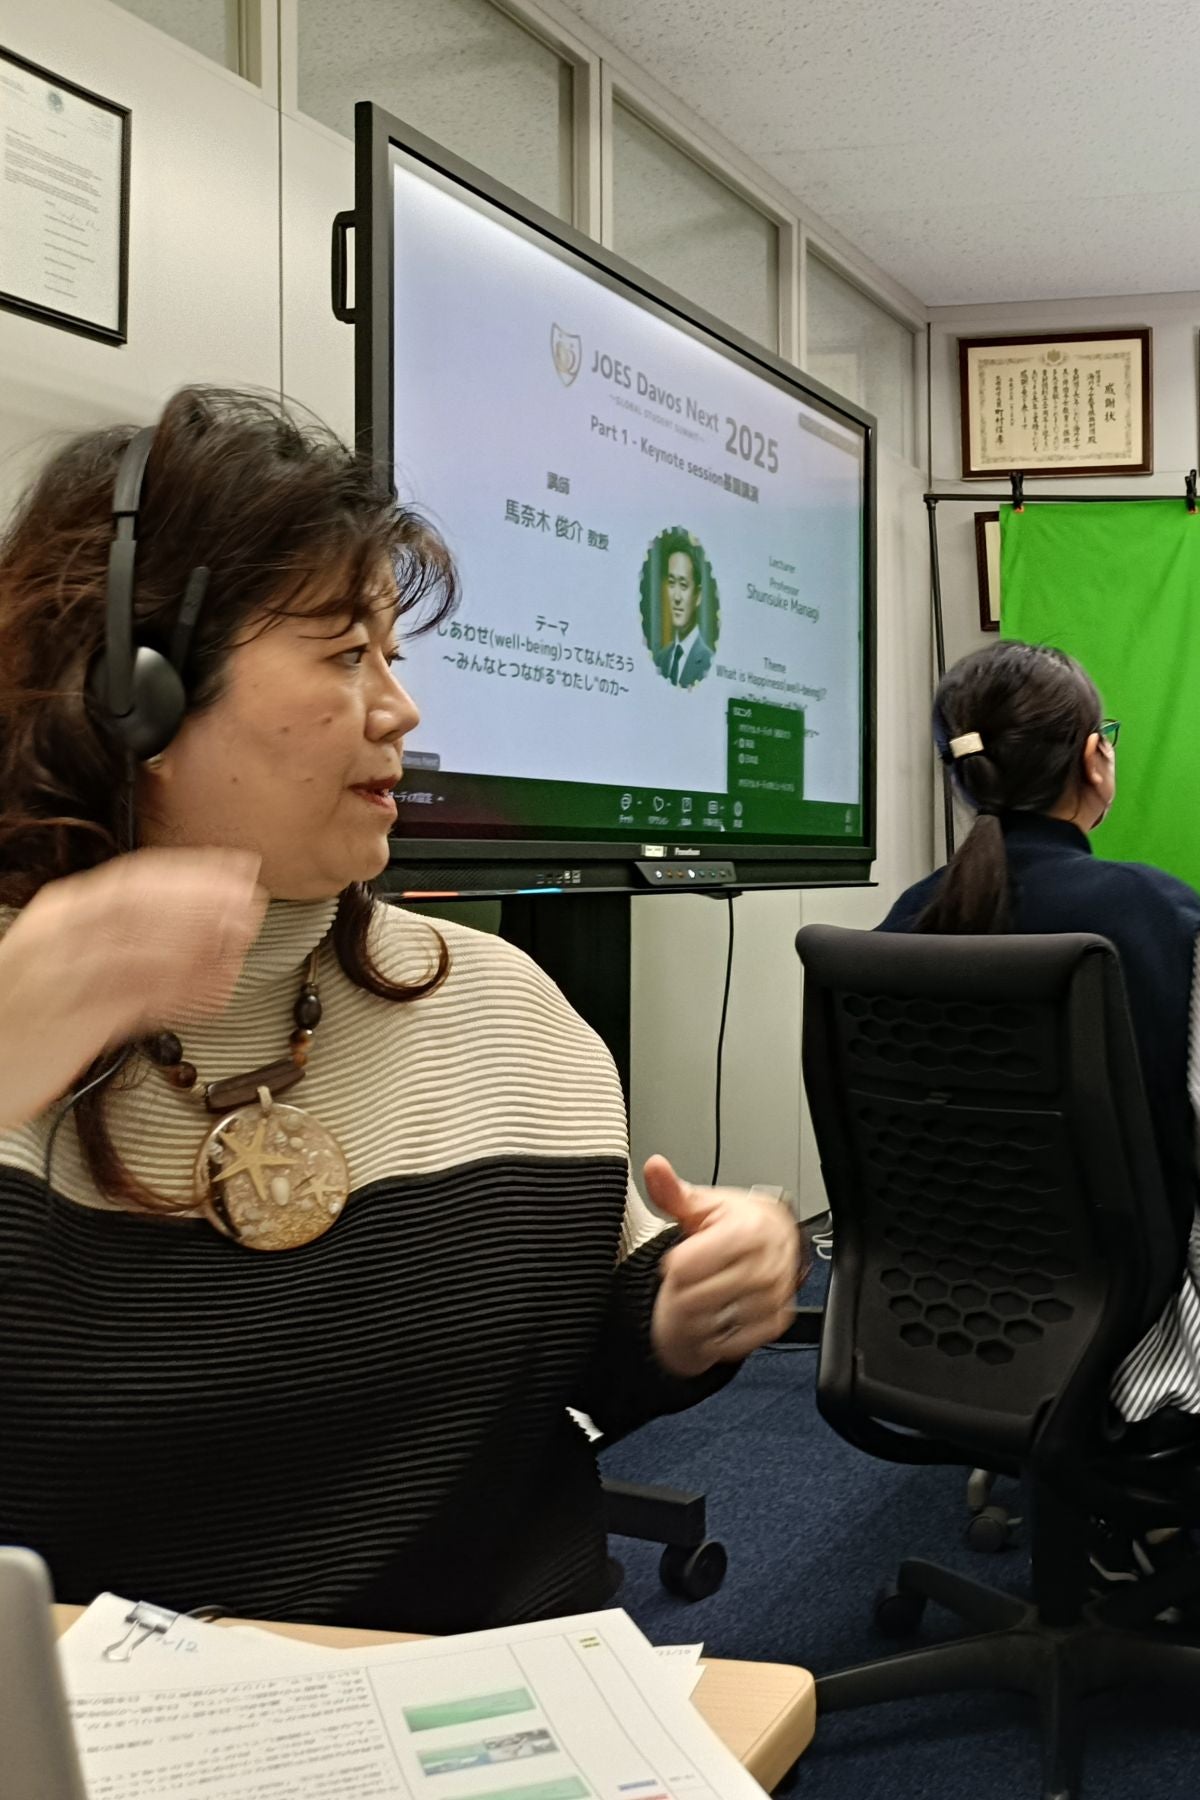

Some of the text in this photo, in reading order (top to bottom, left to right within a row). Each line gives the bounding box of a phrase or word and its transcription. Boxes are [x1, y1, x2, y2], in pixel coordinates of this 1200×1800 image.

[591, 350, 779, 474] JOES Davos Next 2025
[591, 415, 618, 442] Part
[622, 429, 628, 445] 1
[640, 437, 685, 471] Keynote
[504, 499, 550, 532] 馬奈木
[535, 615, 569, 635] テーマ
